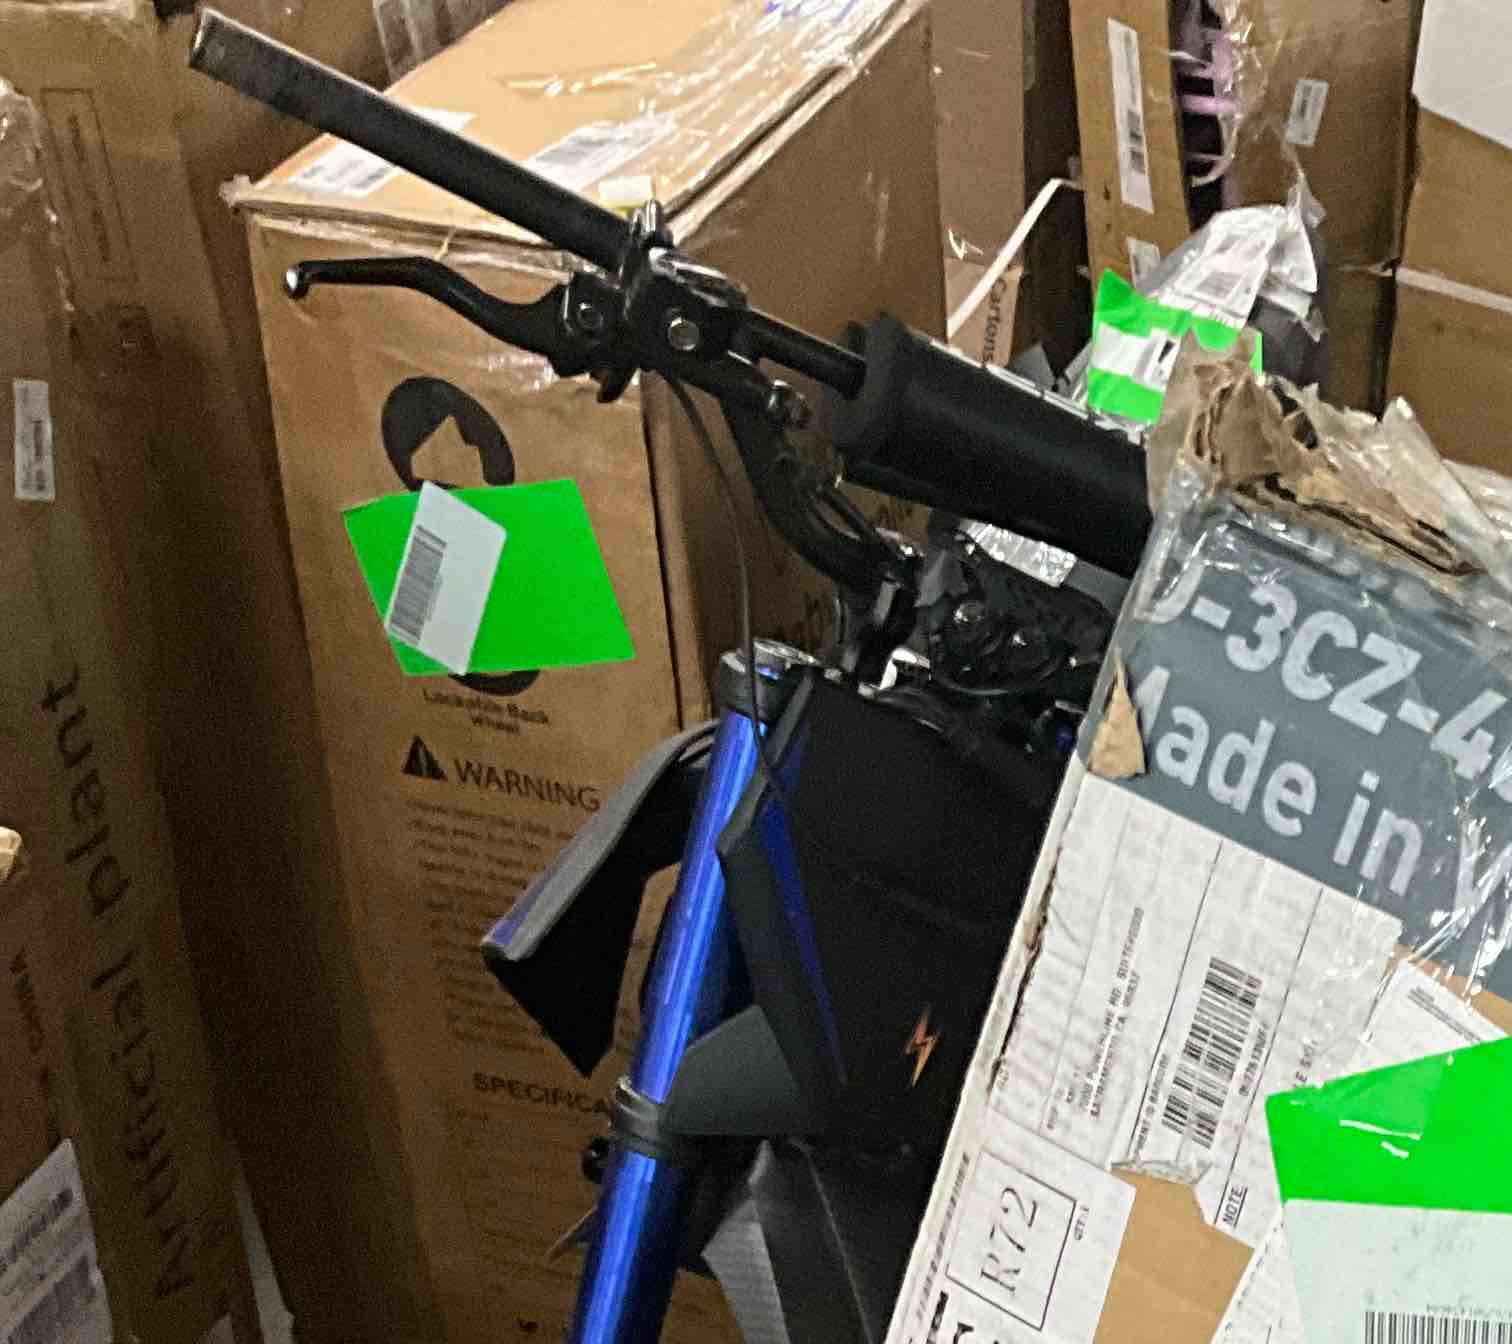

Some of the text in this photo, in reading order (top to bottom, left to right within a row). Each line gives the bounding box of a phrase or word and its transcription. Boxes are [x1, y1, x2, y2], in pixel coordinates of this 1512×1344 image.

[453, 757, 602, 813] WARNING
[1333, 769, 1425, 897] in
[978, 1186, 1039, 1293] R72
